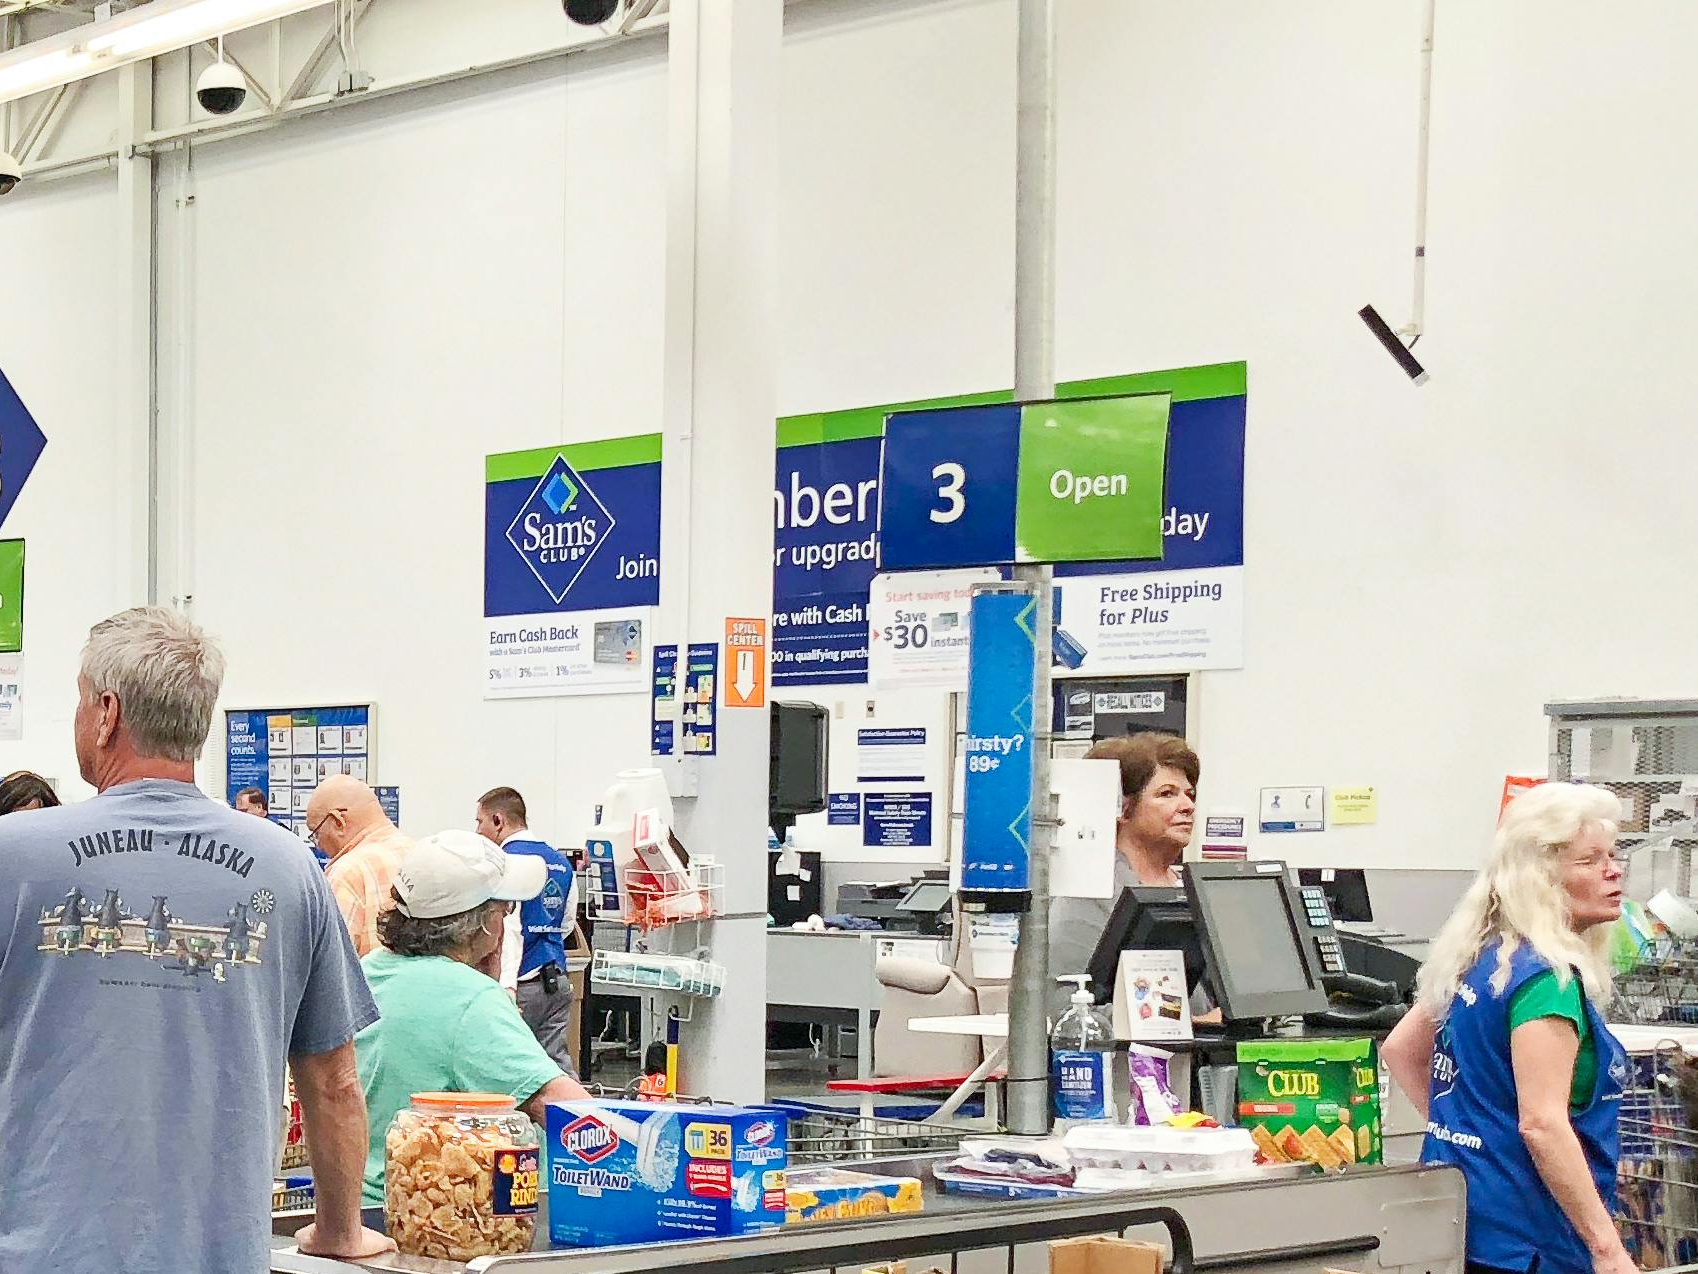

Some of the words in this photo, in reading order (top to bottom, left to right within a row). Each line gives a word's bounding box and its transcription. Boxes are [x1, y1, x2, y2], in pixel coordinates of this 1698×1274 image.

[929, 462, 967, 524] 3
[1049, 468, 1128, 505] Open
[522, 511, 597, 552] Sam's
[615, 554, 658, 580] Join
[885, 591, 914, 603] Start
[916, 590, 950, 603] saving
[1100, 586, 1139, 603] Free
[1142, 580, 1222, 604] Shipping
[790, 605, 823, 626] with
[825, 604, 863, 623] Cash
[894, 609, 928, 624] Save
[1098, 609, 1126, 626] for
[1130, 606, 1169, 625] Plus
[490, 630, 517, 645] Earn
[518, 628, 548, 643] Cash
[549, 625, 579, 641] Back
[733, 622, 758, 634] SPILL
[883, 623, 929, 650] $30
[727, 634, 764, 646] CENTER
[784, 651, 794, 662] in
[794, 649, 840, 665] qualifying
[489, 668, 502, 680] 5%
[555, 665, 569, 677] 1%
[230, 720, 251, 734] Every
[230, 733, 256, 744] second
[230, 746, 257, 756] counts.
[969, 755, 1001, 773] 89¢
[68, 828, 154, 867] JUNEAU
[177, 832, 255, 878] ALASKA
[1267, 1070, 1320, 1097] CLUB
[567, 1123, 614, 1151] CLOROX
[708, 1129, 728, 1147] 36
